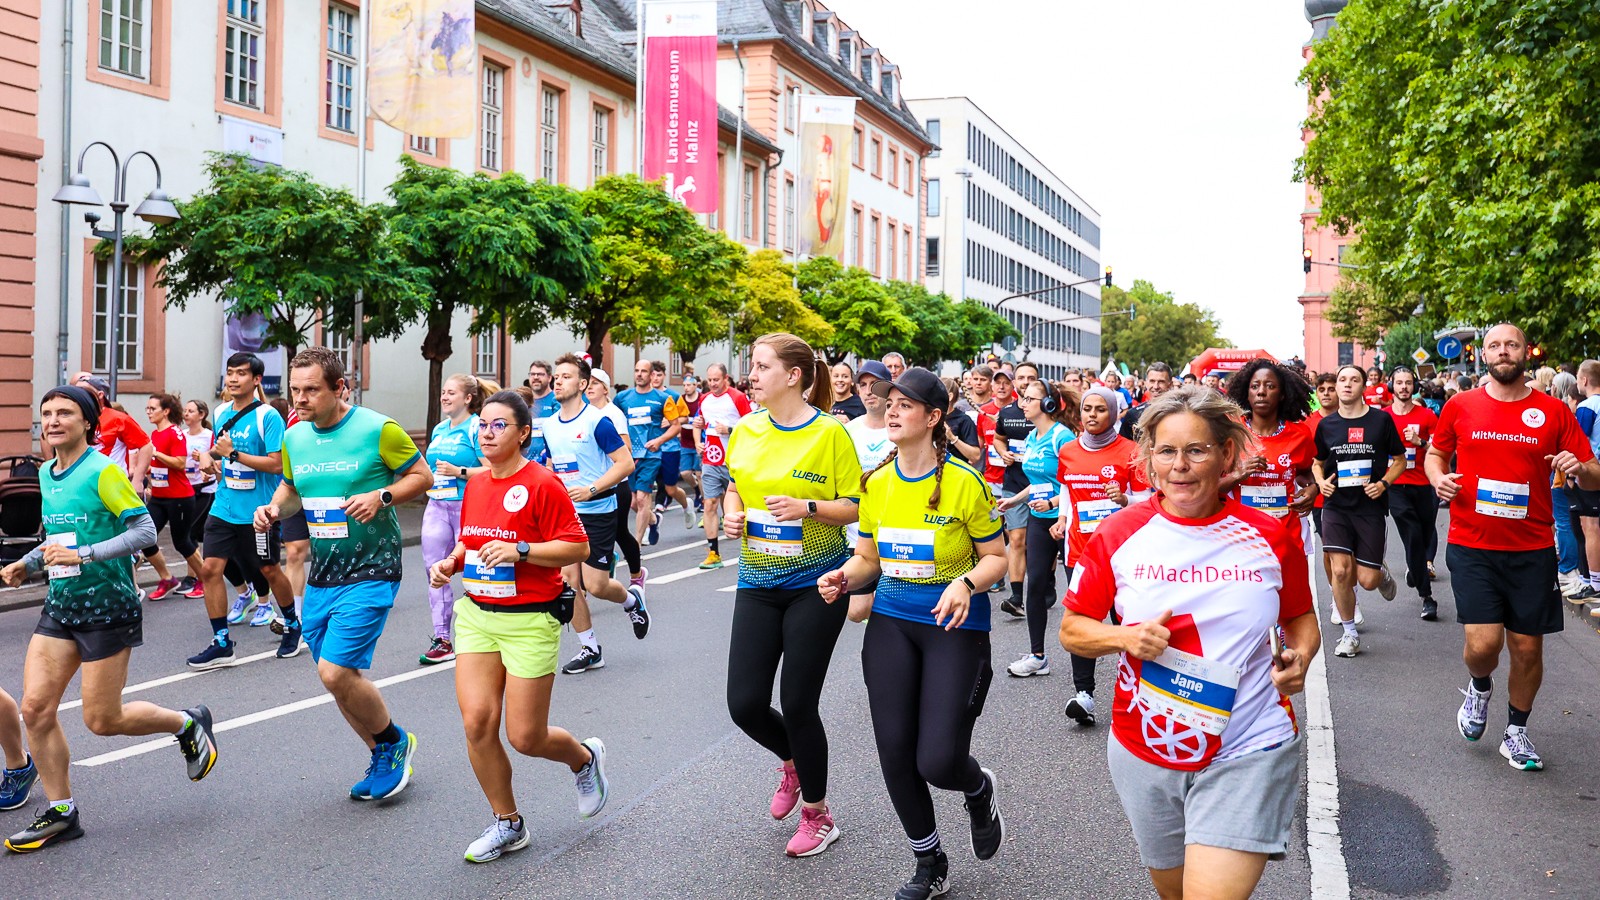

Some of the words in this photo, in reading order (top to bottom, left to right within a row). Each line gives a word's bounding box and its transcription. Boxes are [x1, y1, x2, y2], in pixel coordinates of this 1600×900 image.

[666, 50, 680, 164] Landesmuseum
[685, 120, 699, 164] Mainz
[1471, 431, 1538, 445] MitMenschen
[792, 469, 828, 484] wepa
[1491, 491, 1514, 501] Simon
[762, 524, 782, 534] Lena
[254, 532, 268, 556] PUM
[891, 543, 914, 555] Freya
[1133, 564, 1263, 583] #MachDeins
[1171, 673, 1204, 693] Jane
[1177, 689, 1191, 699] 327
